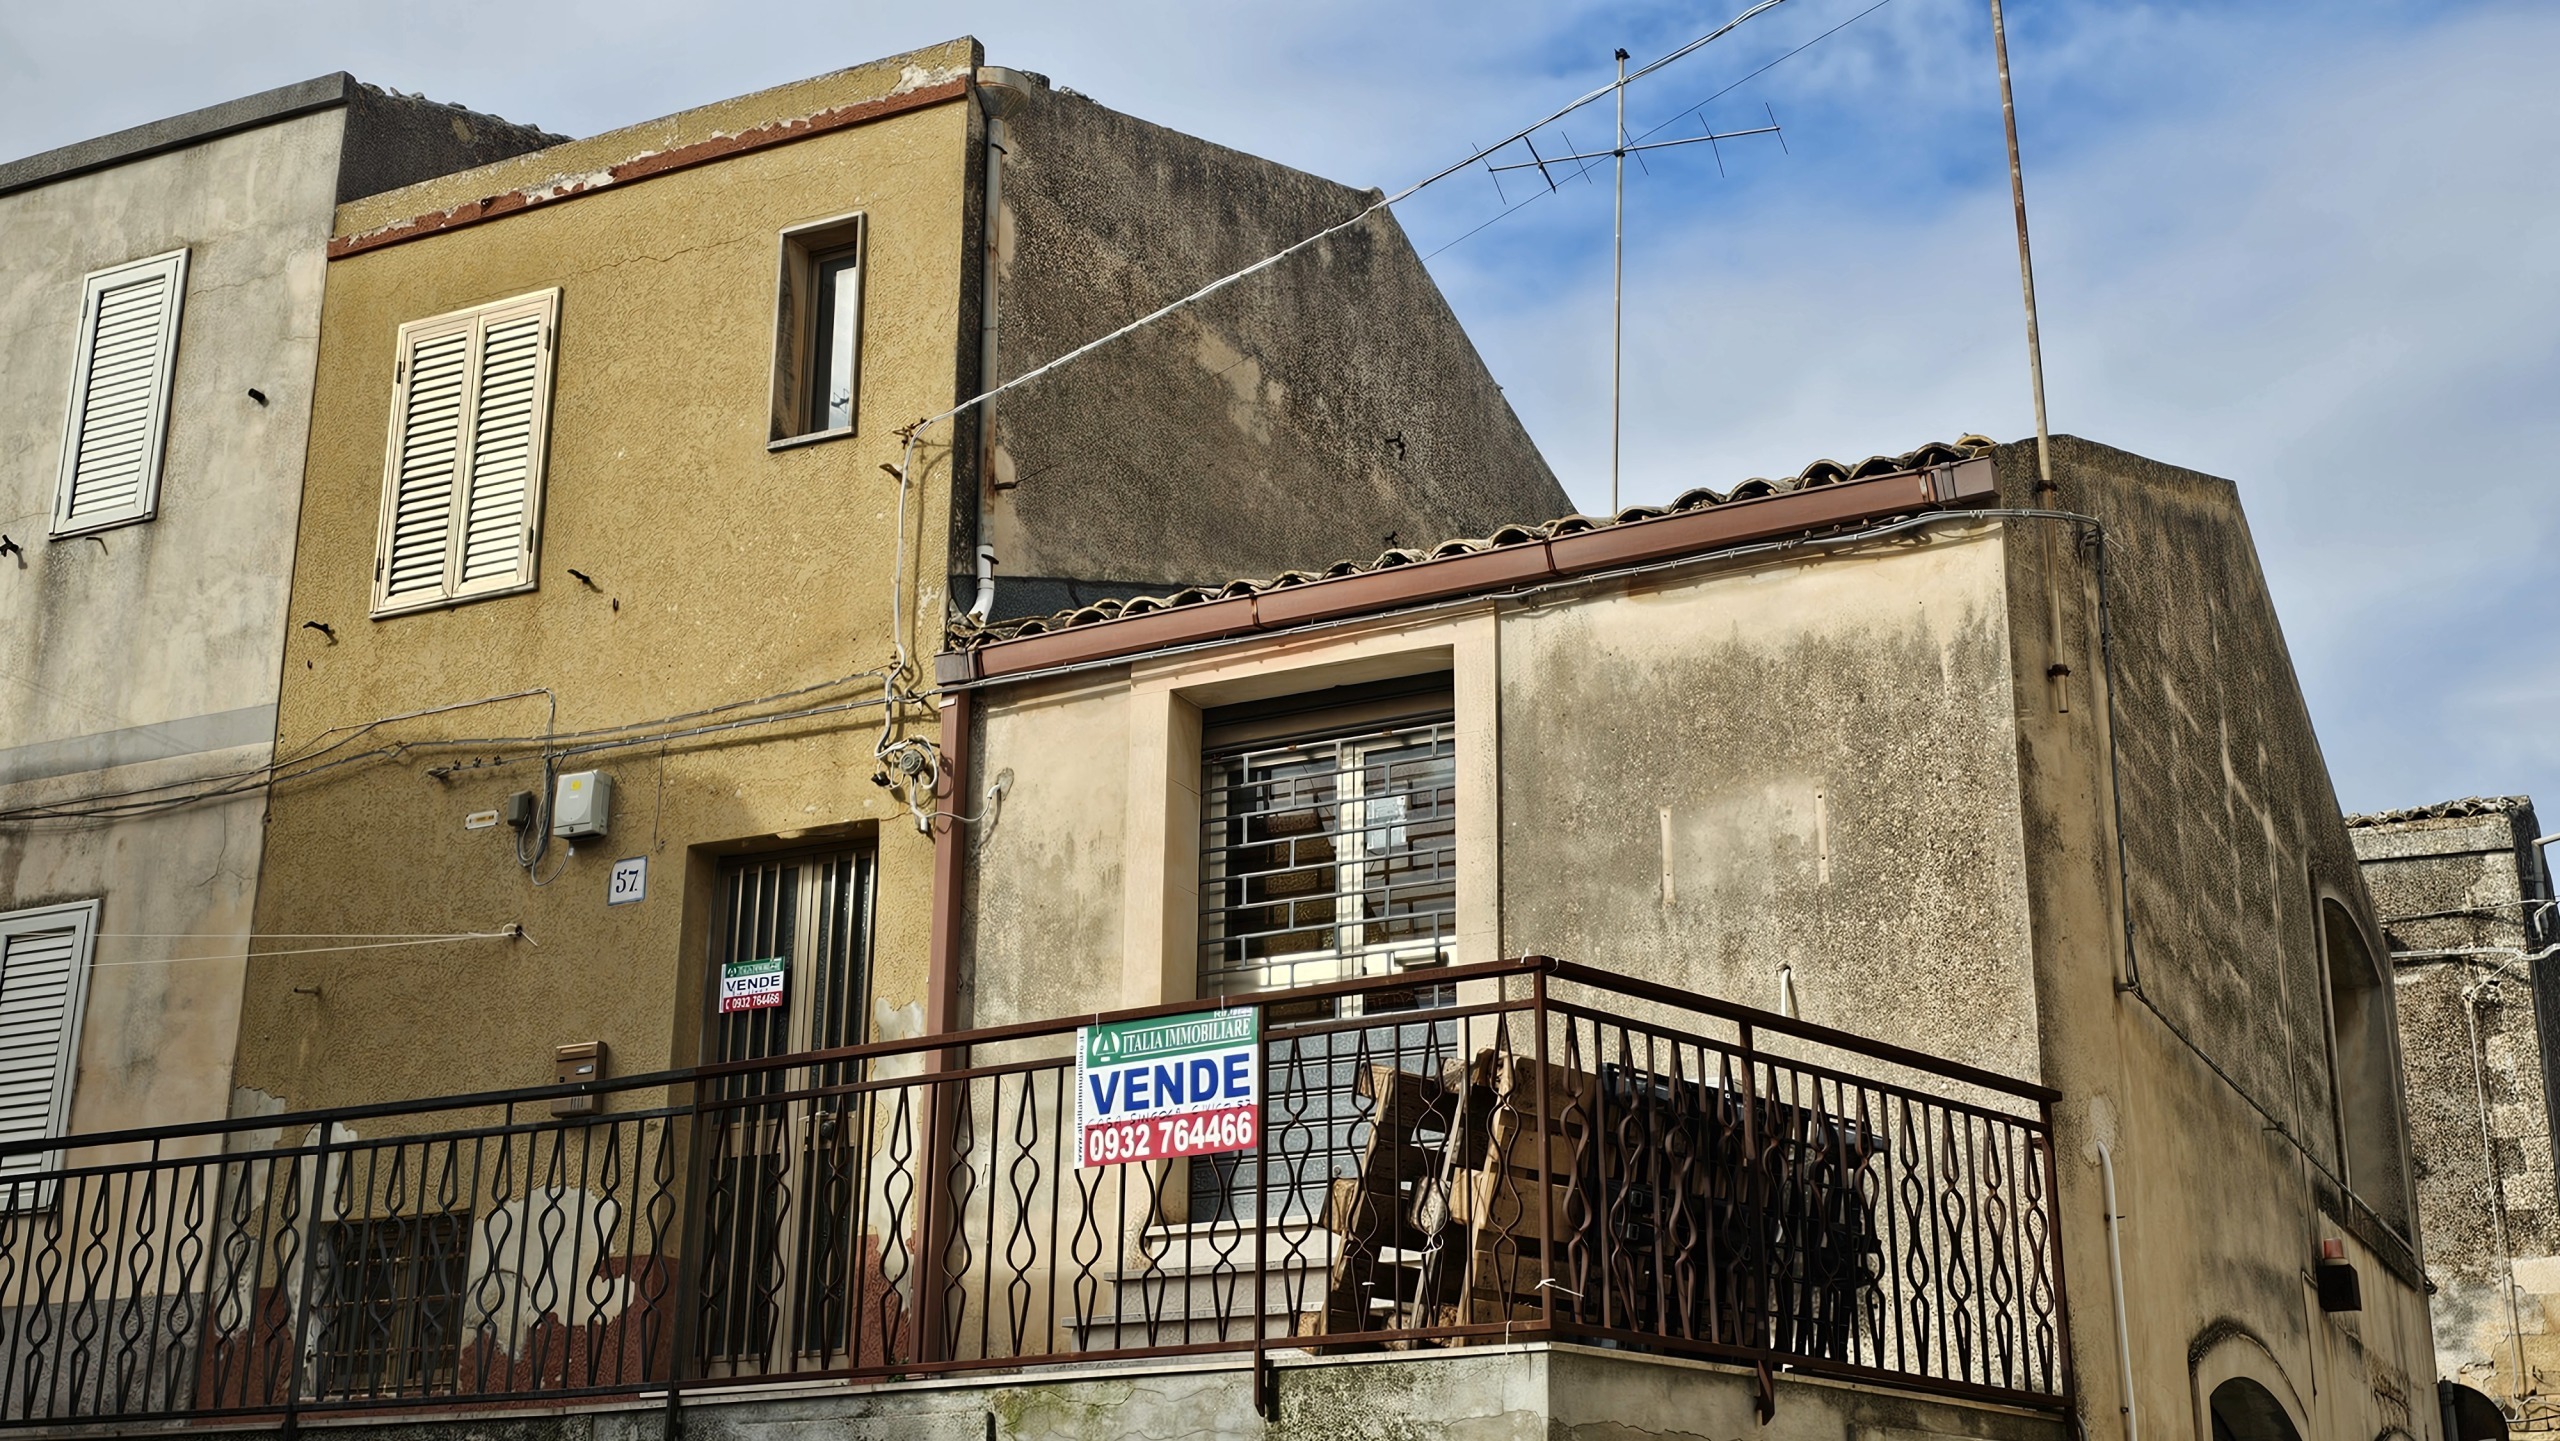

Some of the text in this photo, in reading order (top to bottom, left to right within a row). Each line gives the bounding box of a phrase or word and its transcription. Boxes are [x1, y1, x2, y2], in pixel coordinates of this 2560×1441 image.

[726, 975, 780, 992] VENDE
[732, 997, 750, 1009] 0932
[1123, 1029, 1163, 1053] ITALIA
[1165, 1018, 1251, 1048] IMMOBILIARE
[1089, 1053, 1250, 1115] VENDE
[1086, 1116, 1122, 1131] CASA
[1089, 1111, 1252, 1162] 0932 764466
